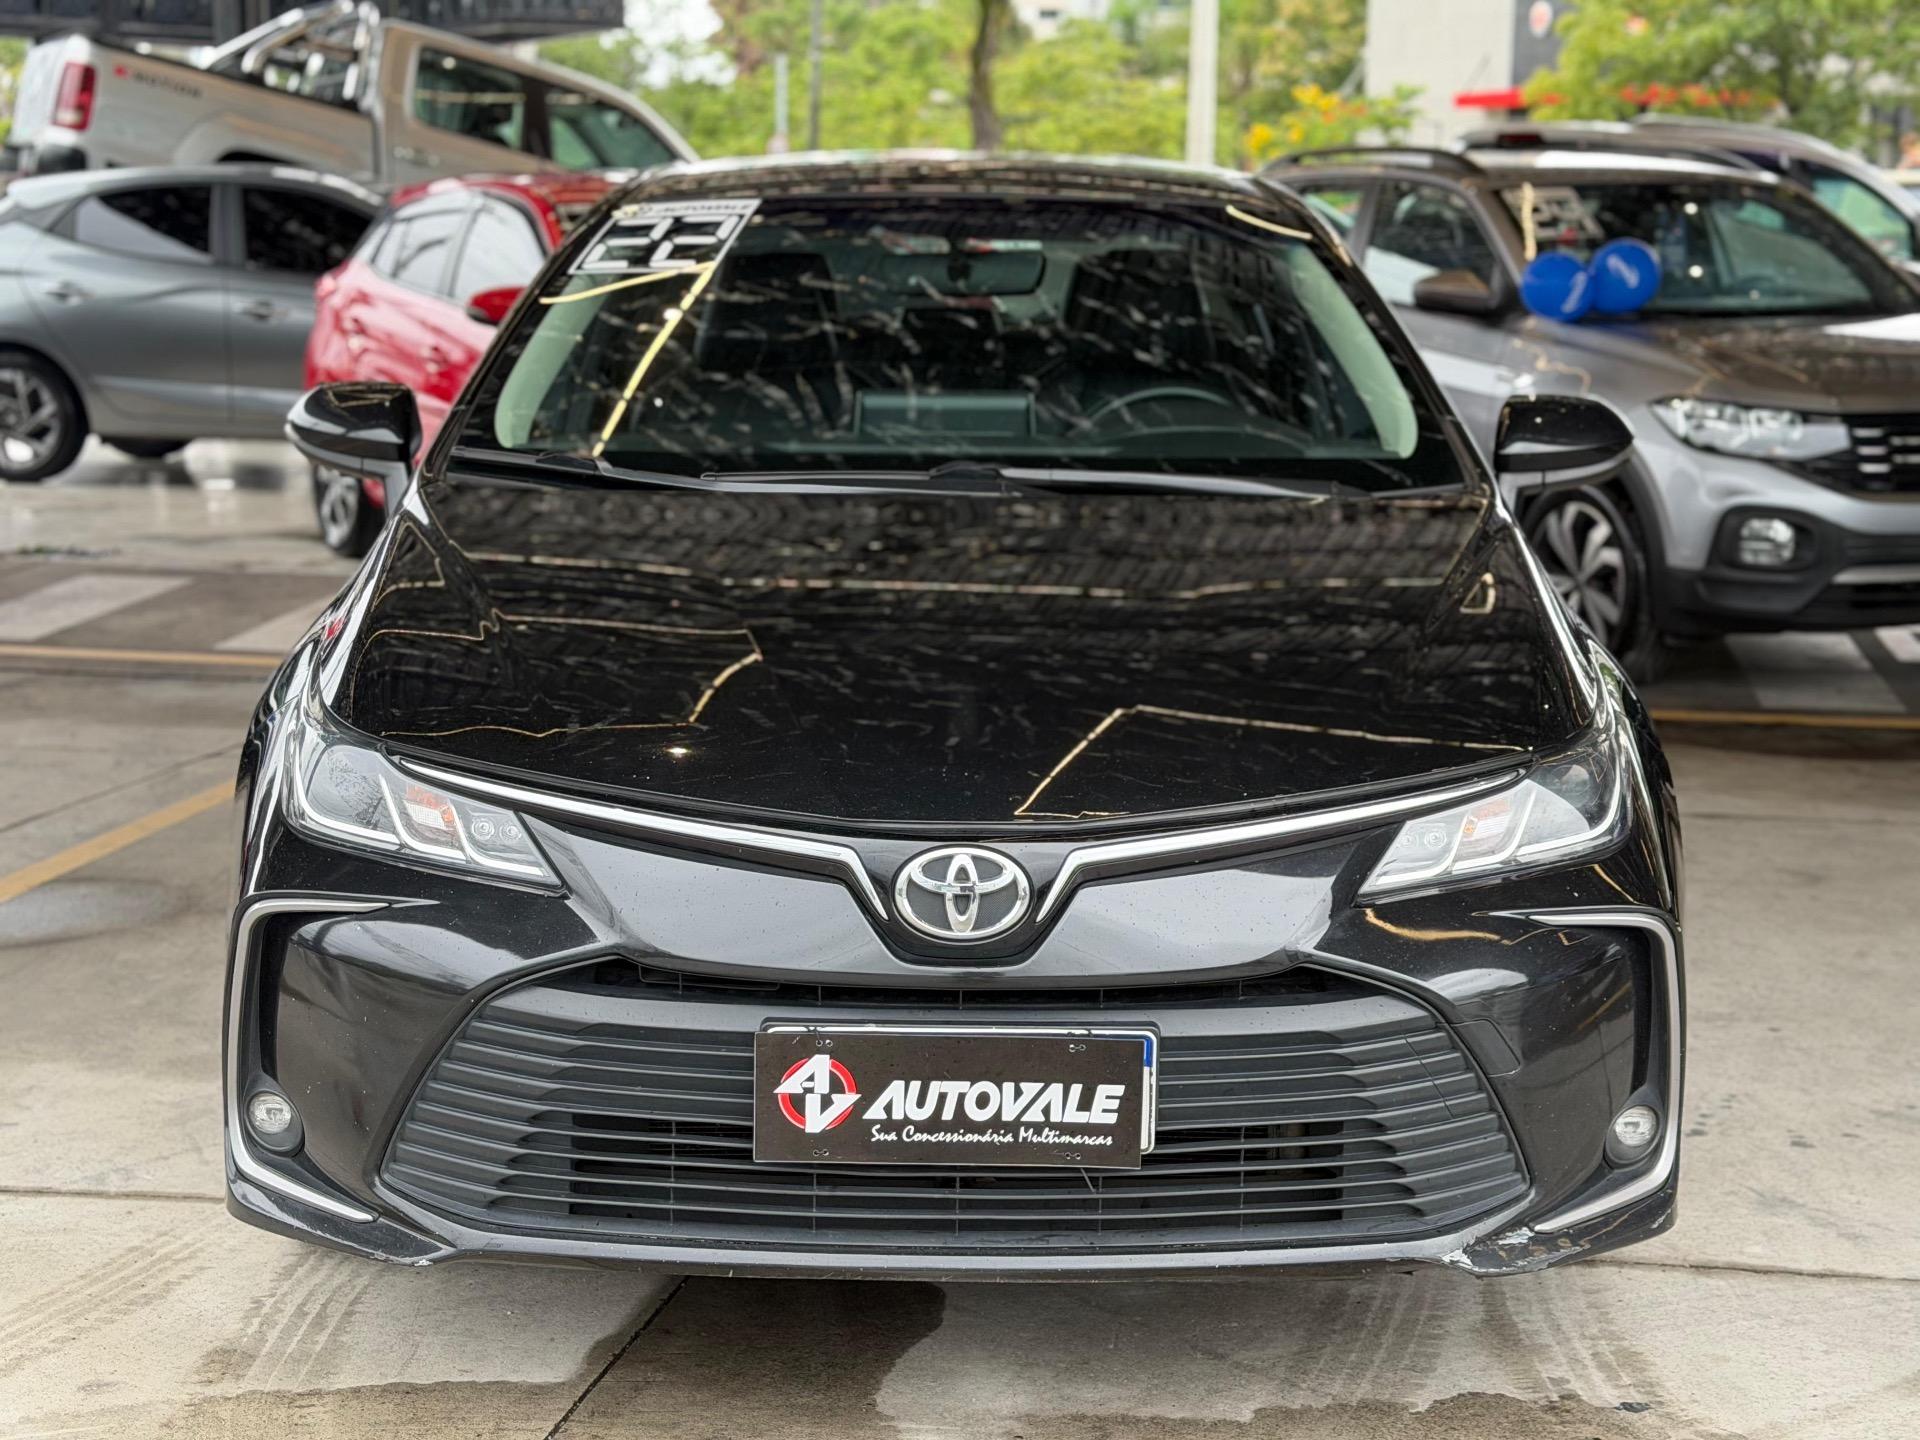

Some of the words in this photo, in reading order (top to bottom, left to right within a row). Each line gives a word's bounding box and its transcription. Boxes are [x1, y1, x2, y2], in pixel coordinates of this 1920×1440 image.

[582, 215, 741, 270] 22
[862, 1080, 1125, 1124] AUTOVALE
[871, 1124, 898, 1142] Sua
[902, 1125, 1014, 1145] Concessionária
[1018, 1126, 1113, 1146] Multimarcas
